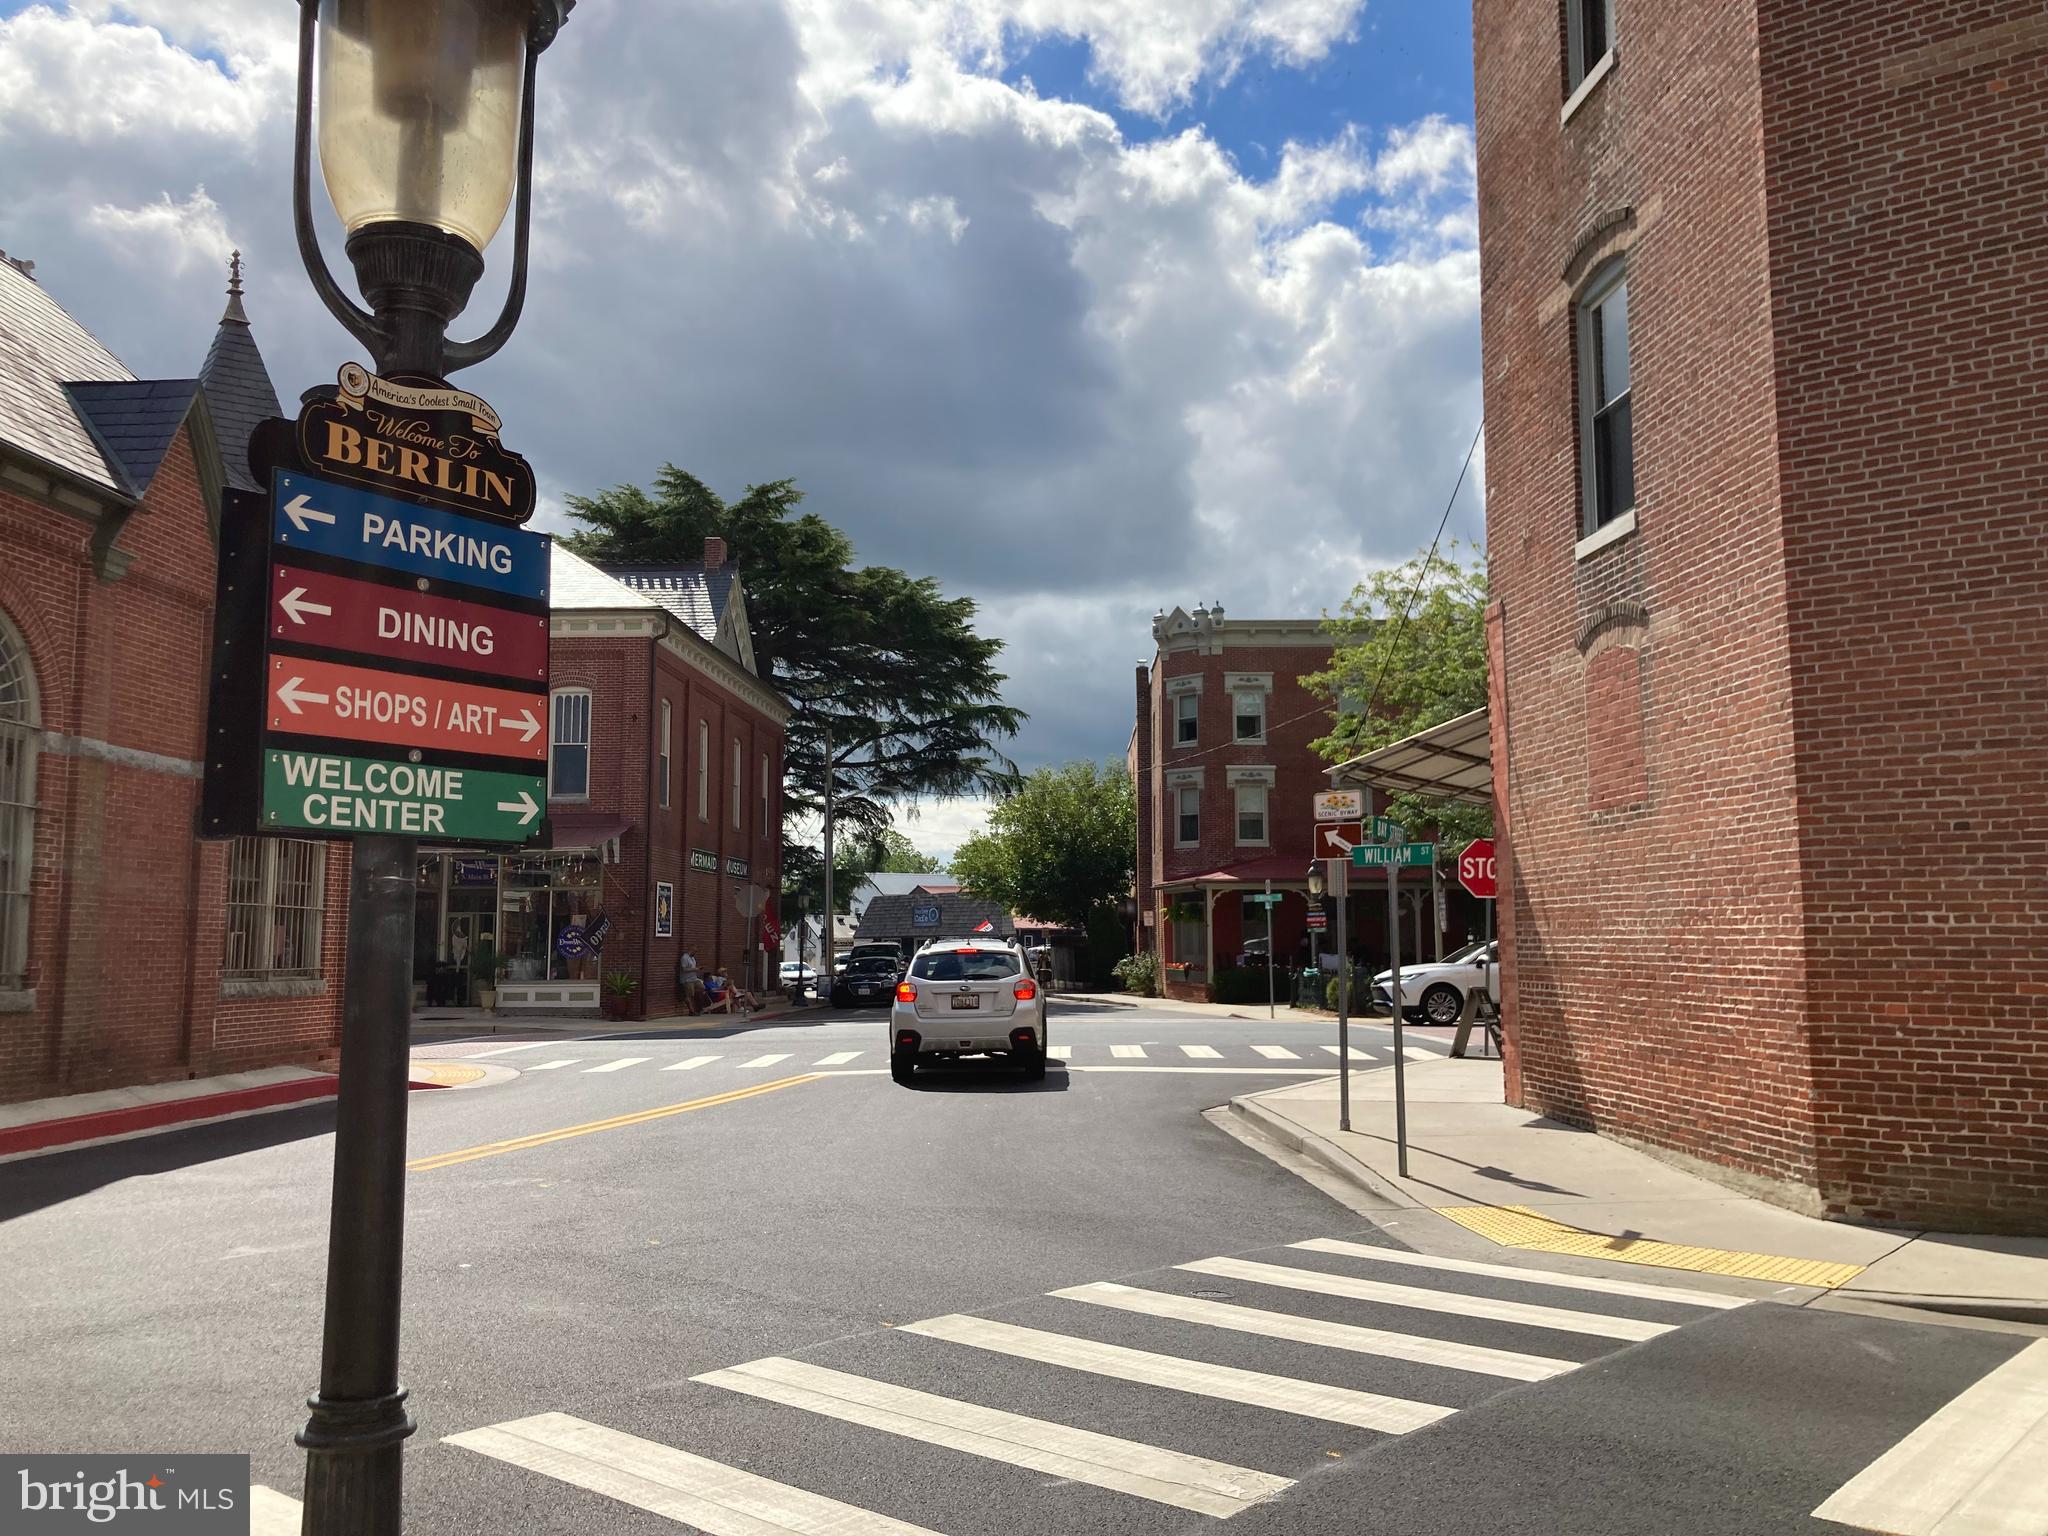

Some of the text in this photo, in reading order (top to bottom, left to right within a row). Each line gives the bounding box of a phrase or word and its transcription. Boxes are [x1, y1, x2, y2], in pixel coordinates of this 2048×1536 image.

[371, 379, 497, 424] America's Coolest Small Town
[366, 409, 484, 459] Welcome To
[323, 420, 515, 506] BERLIN
[362, 512, 513, 574] PARKING
[378, 606, 495, 655] DINING
[334, 685, 427, 727] SHOPS
[446, 702, 498, 736] ART
[282, 754, 463, 801] WELCOME
[302, 793, 446, 833] CENTER
[690, 850, 717, 870] MERMAID
[1364, 846, 1430, 864] WILLIAM ST
[1463, 857, 1496, 880] STO
